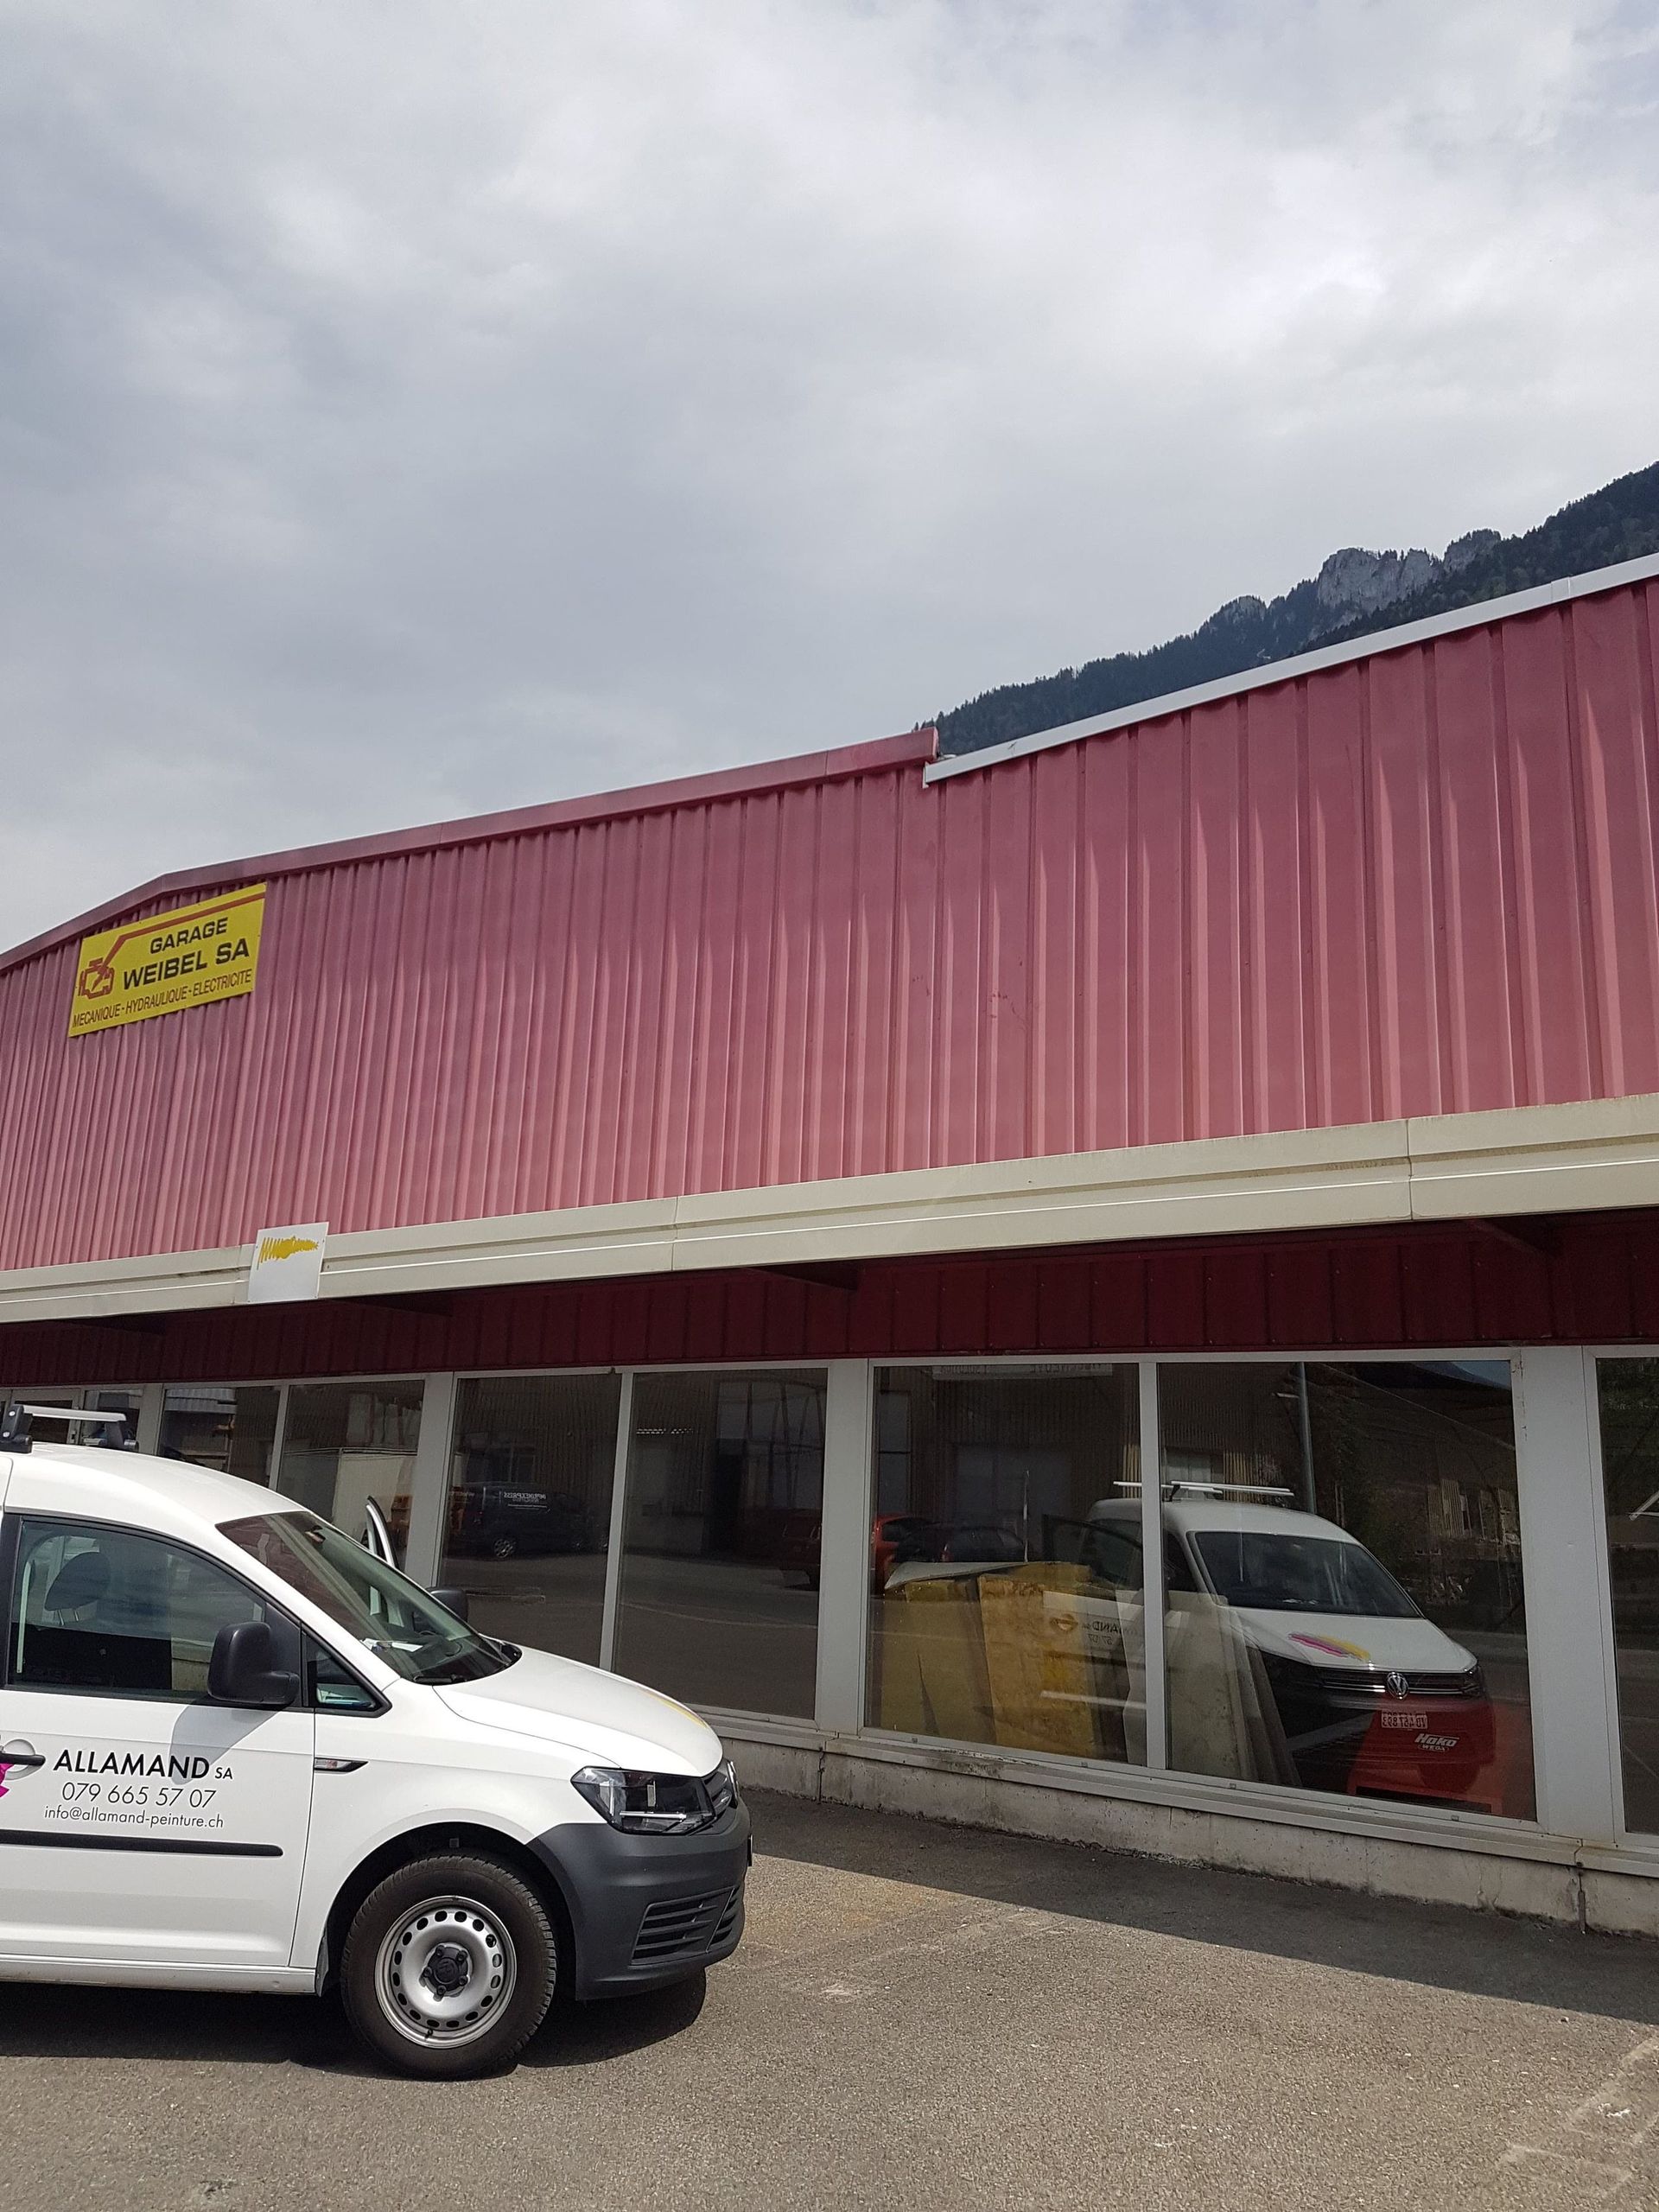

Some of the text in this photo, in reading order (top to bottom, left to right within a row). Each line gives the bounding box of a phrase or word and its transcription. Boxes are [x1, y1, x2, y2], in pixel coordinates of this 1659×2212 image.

[149, 917, 229, 955] GARAGE
[123, 938, 250, 990] WEIBEL SA
[53, 1749, 233, 1780] ALLAMAND SA
[61, 1782, 217, 1808] 079 665 57 07
[44, 1805, 225, 1829] info@allamand-peinture.ch
